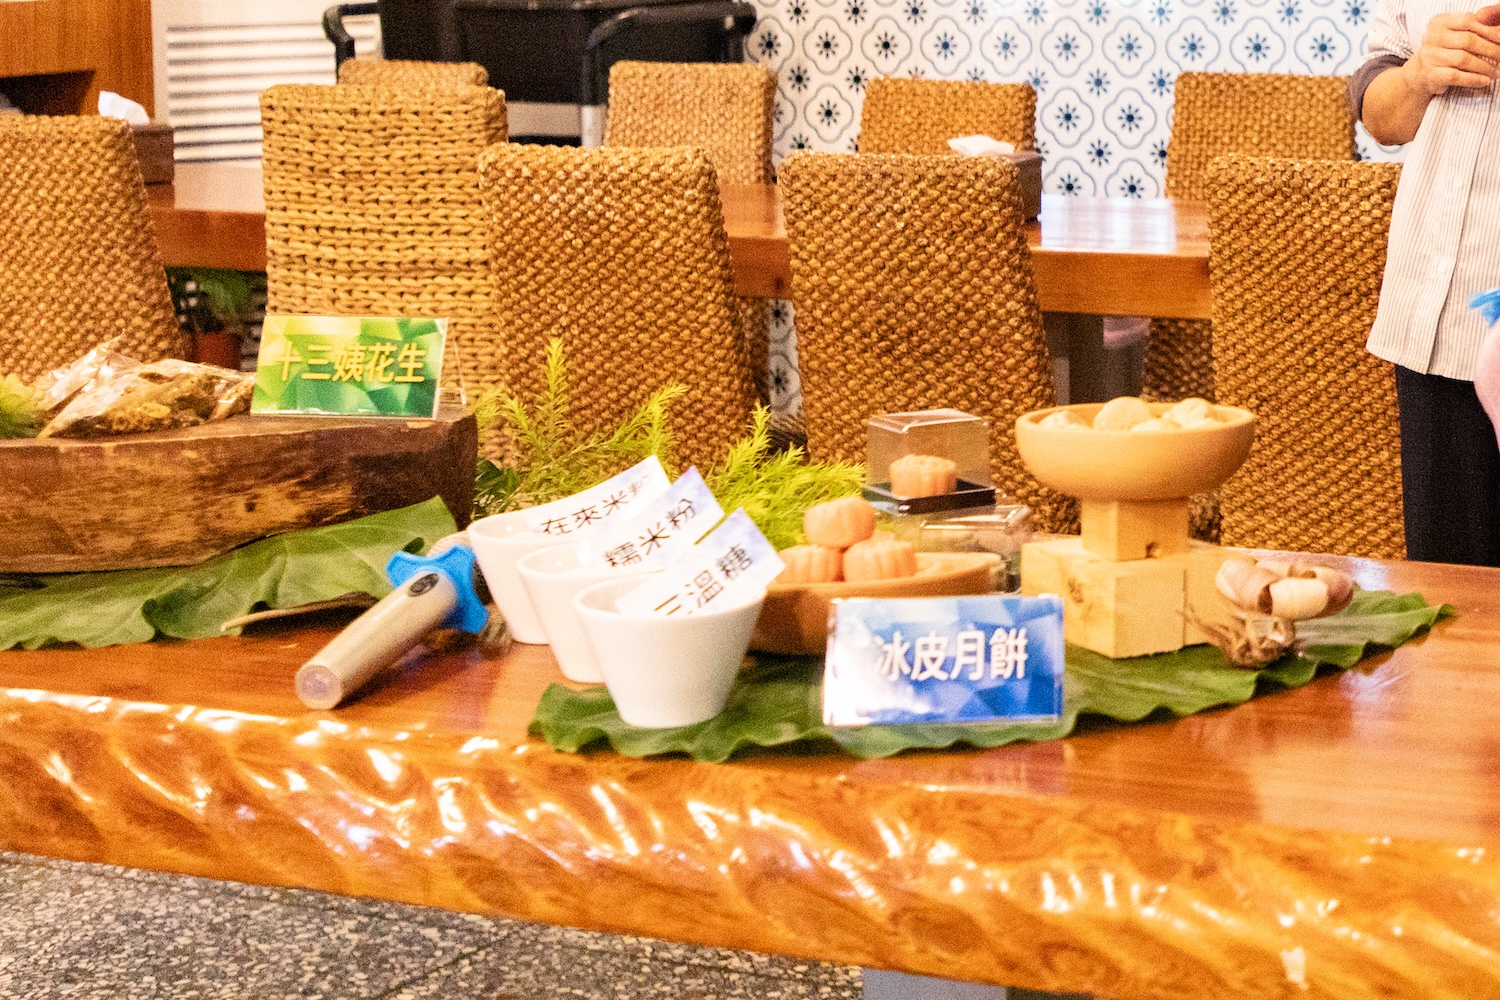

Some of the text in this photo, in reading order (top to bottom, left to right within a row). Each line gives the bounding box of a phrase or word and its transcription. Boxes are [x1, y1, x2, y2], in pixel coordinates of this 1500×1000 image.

[274, 340, 428, 383] 十三姨花生
[602, 498, 696, 568] 糯米粉
[874, 627, 1029, 682] 冰皮月餅
